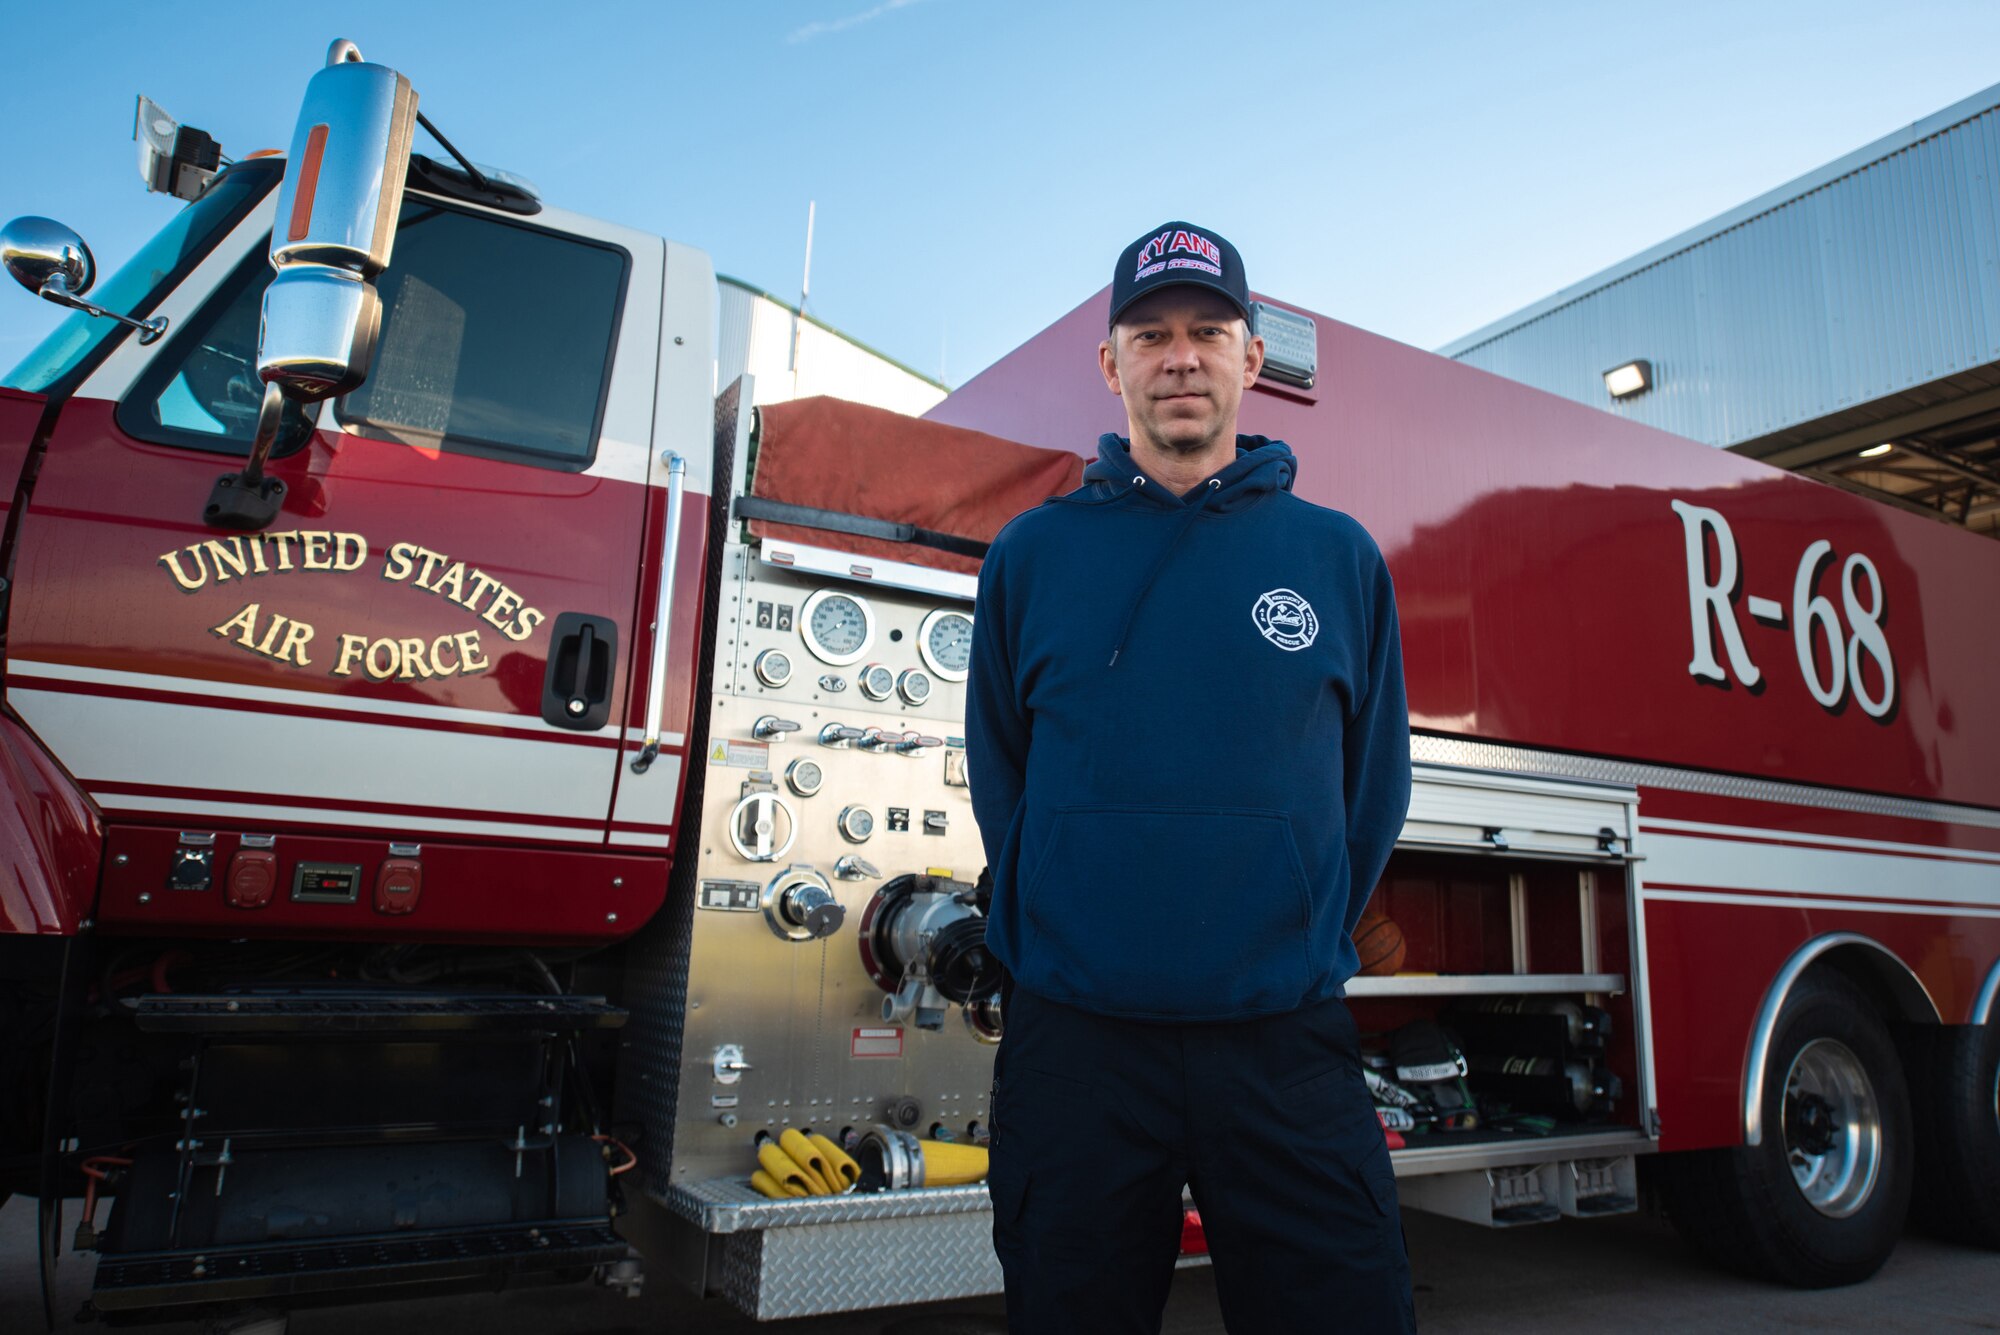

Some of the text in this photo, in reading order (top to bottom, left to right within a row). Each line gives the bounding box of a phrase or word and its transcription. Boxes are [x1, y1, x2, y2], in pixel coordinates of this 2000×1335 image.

[1137, 230, 1221, 271] KYANG
[158, 530, 546, 641] UNITED STATES
[1671, 499, 1896, 720] R-68
[213, 603, 489, 679] AIR FORCE
